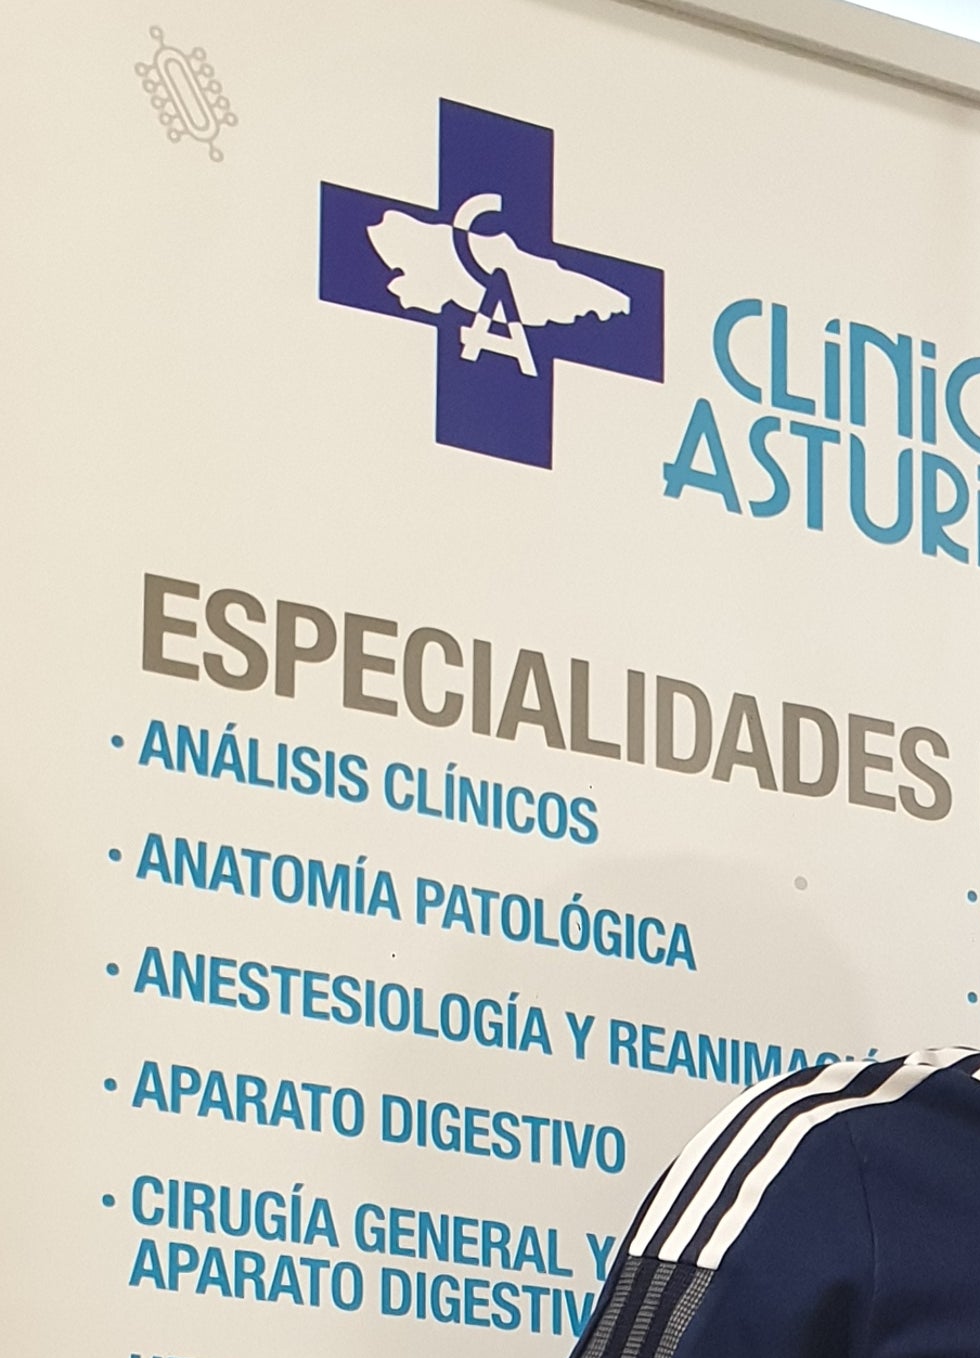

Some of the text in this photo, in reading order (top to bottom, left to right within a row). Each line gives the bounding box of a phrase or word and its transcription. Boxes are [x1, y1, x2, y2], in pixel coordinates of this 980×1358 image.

[142, 572, 953, 828] ESPECIALIDADES
[138, 720, 599, 845] ANÁLISIS CLÍNICOS
[136, 833, 698, 971] ANATOMÍA PATOLÓGICA
[133, 946, 552, 1055] ANESTESIOLOGÍA
[565, 1012, 595, 1060] Y
[131, 1060, 627, 1175] APARATO DIGESTIVO
[128, 1239, 364, 1312] APARATO
[131, 1174, 616, 1283] CIRUGÍA GENERAL Y
